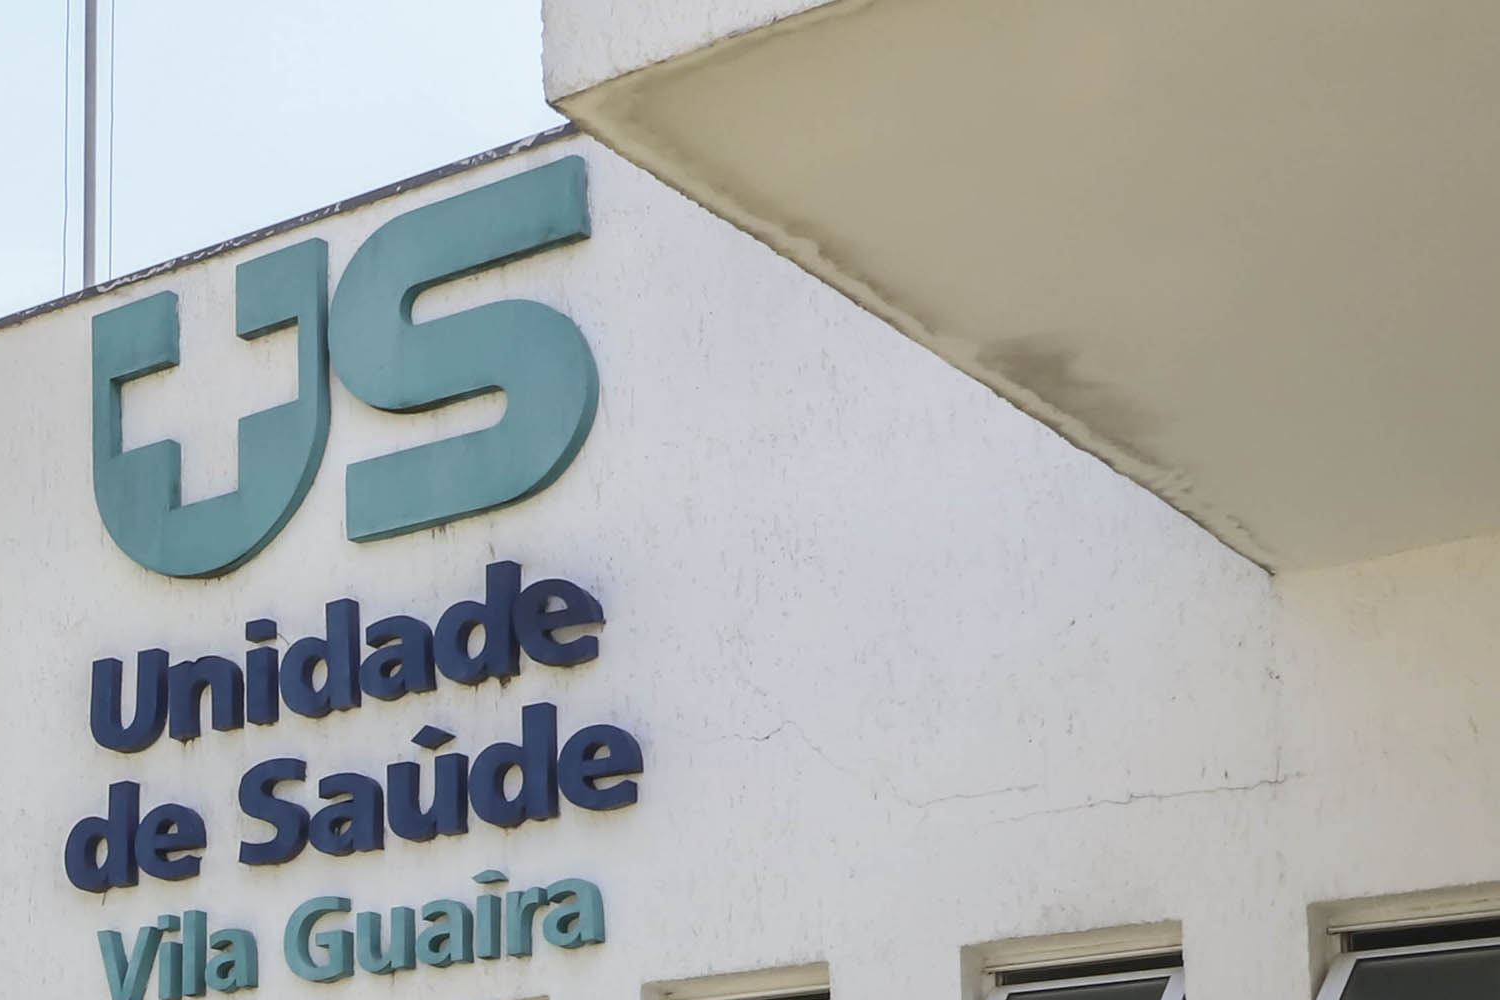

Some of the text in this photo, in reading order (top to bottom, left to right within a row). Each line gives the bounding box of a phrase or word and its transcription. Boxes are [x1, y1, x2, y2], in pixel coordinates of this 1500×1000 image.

[90, 560, 606, 753] Unidade
[65, 702, 643, 893] de Saúde
